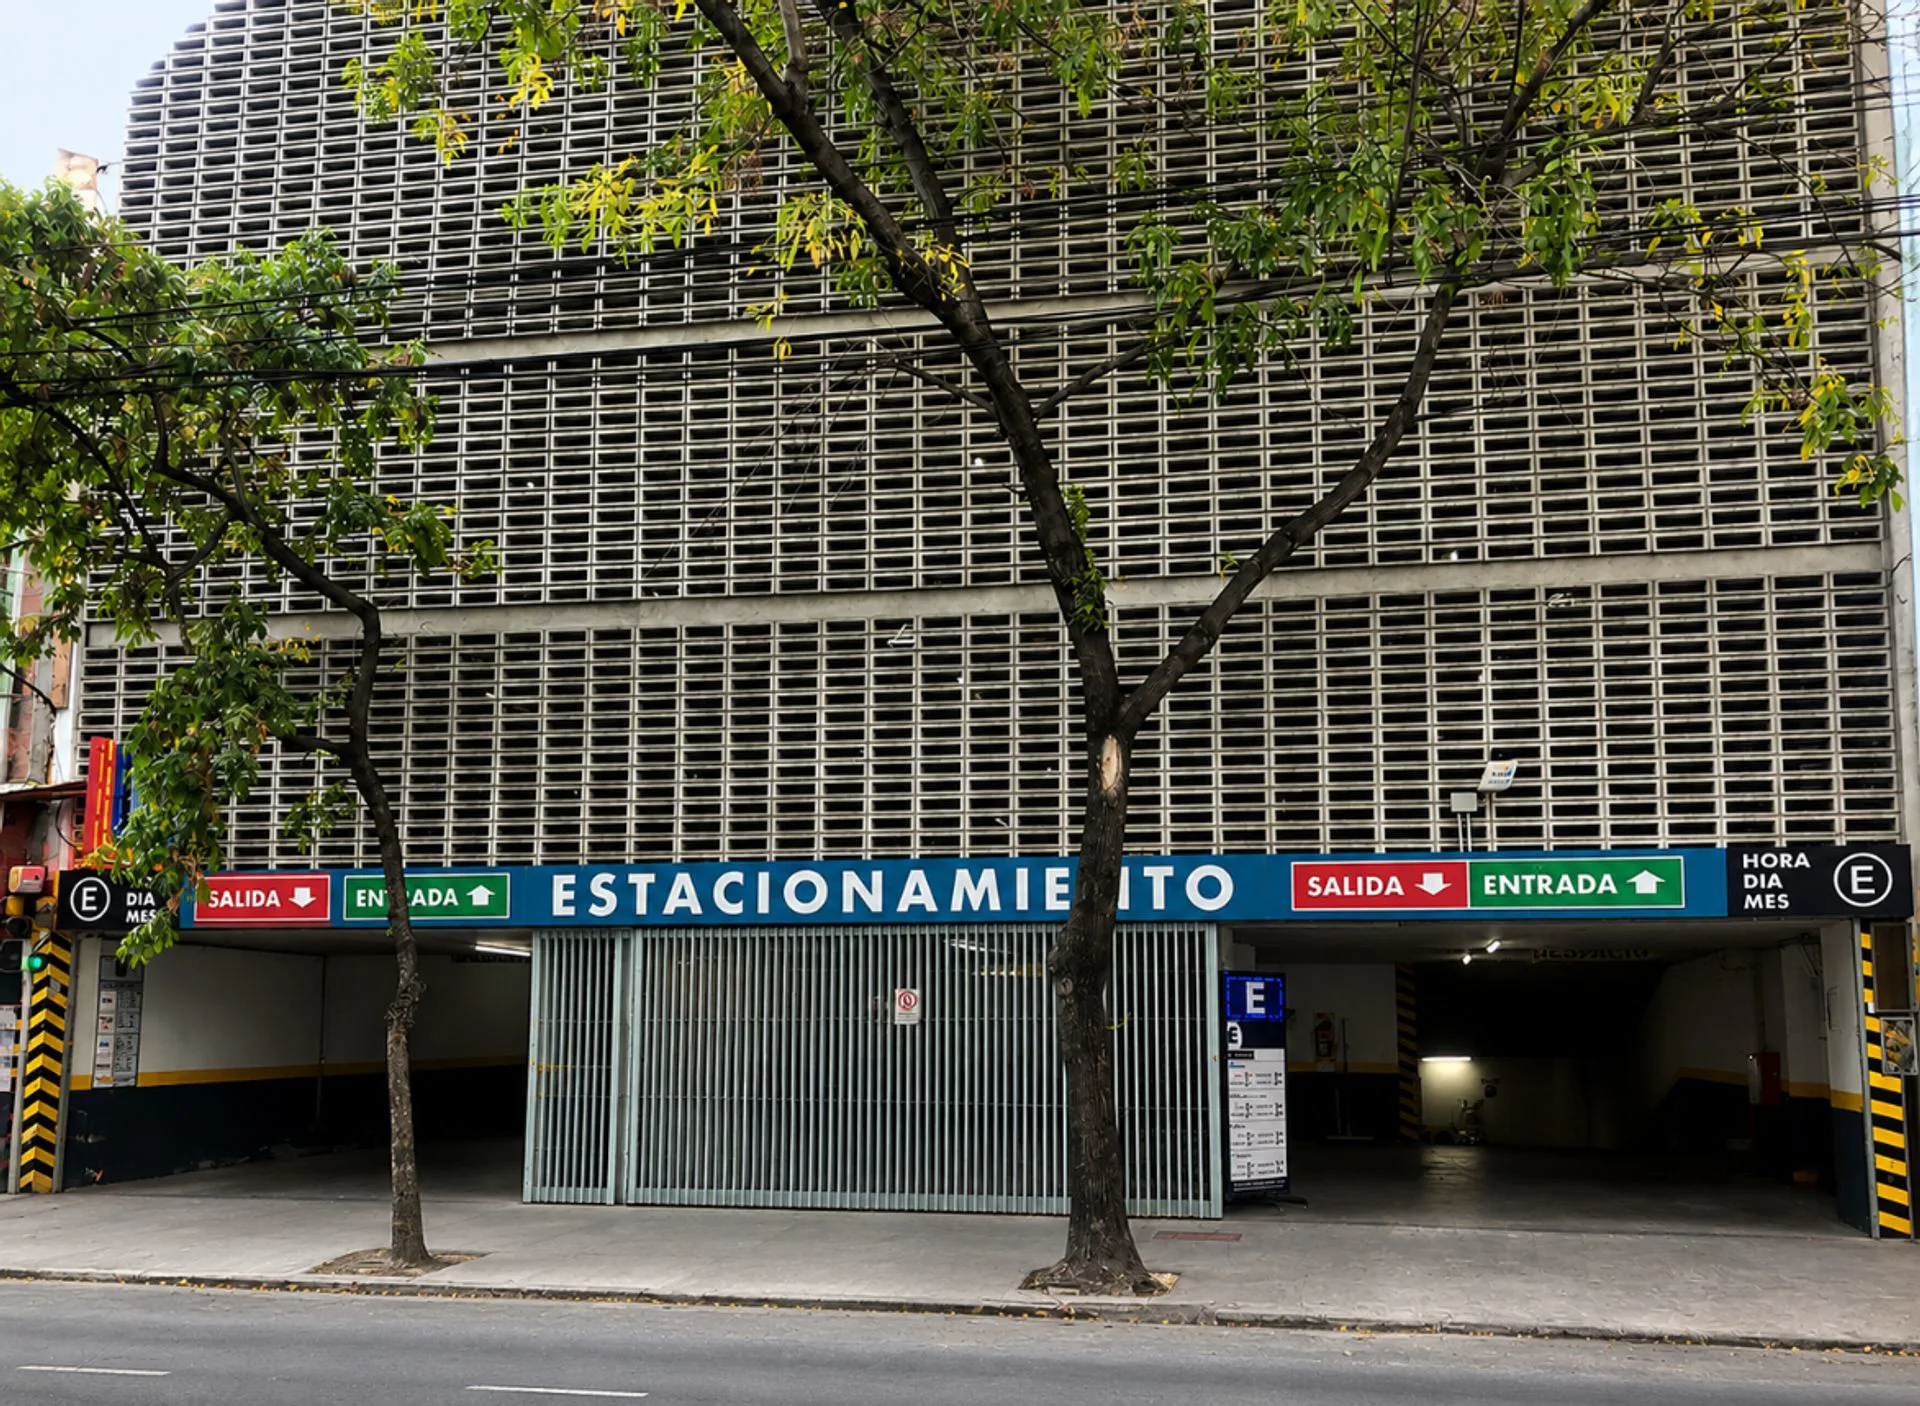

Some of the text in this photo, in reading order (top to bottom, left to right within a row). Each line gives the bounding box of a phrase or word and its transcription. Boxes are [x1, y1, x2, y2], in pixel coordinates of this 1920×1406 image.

[1742, 852, 1811, 869] HORA
[1307, 874, 1405, 897] SALIDA
[1484, 873, 1618, 896] ENTRADA
[1743, 873, 1784, 889] DIA
[1851, 865, 1876, 894] E
[81, 887, 97, 911] E
[126, 892, 155, 906] DIA
[208, 889, 281, 908] SALIDA
[356, 888, 459, 907] ENADA
[1743, 894, 1790, 909] MES
[1246, 981, 1265, 1014] E
